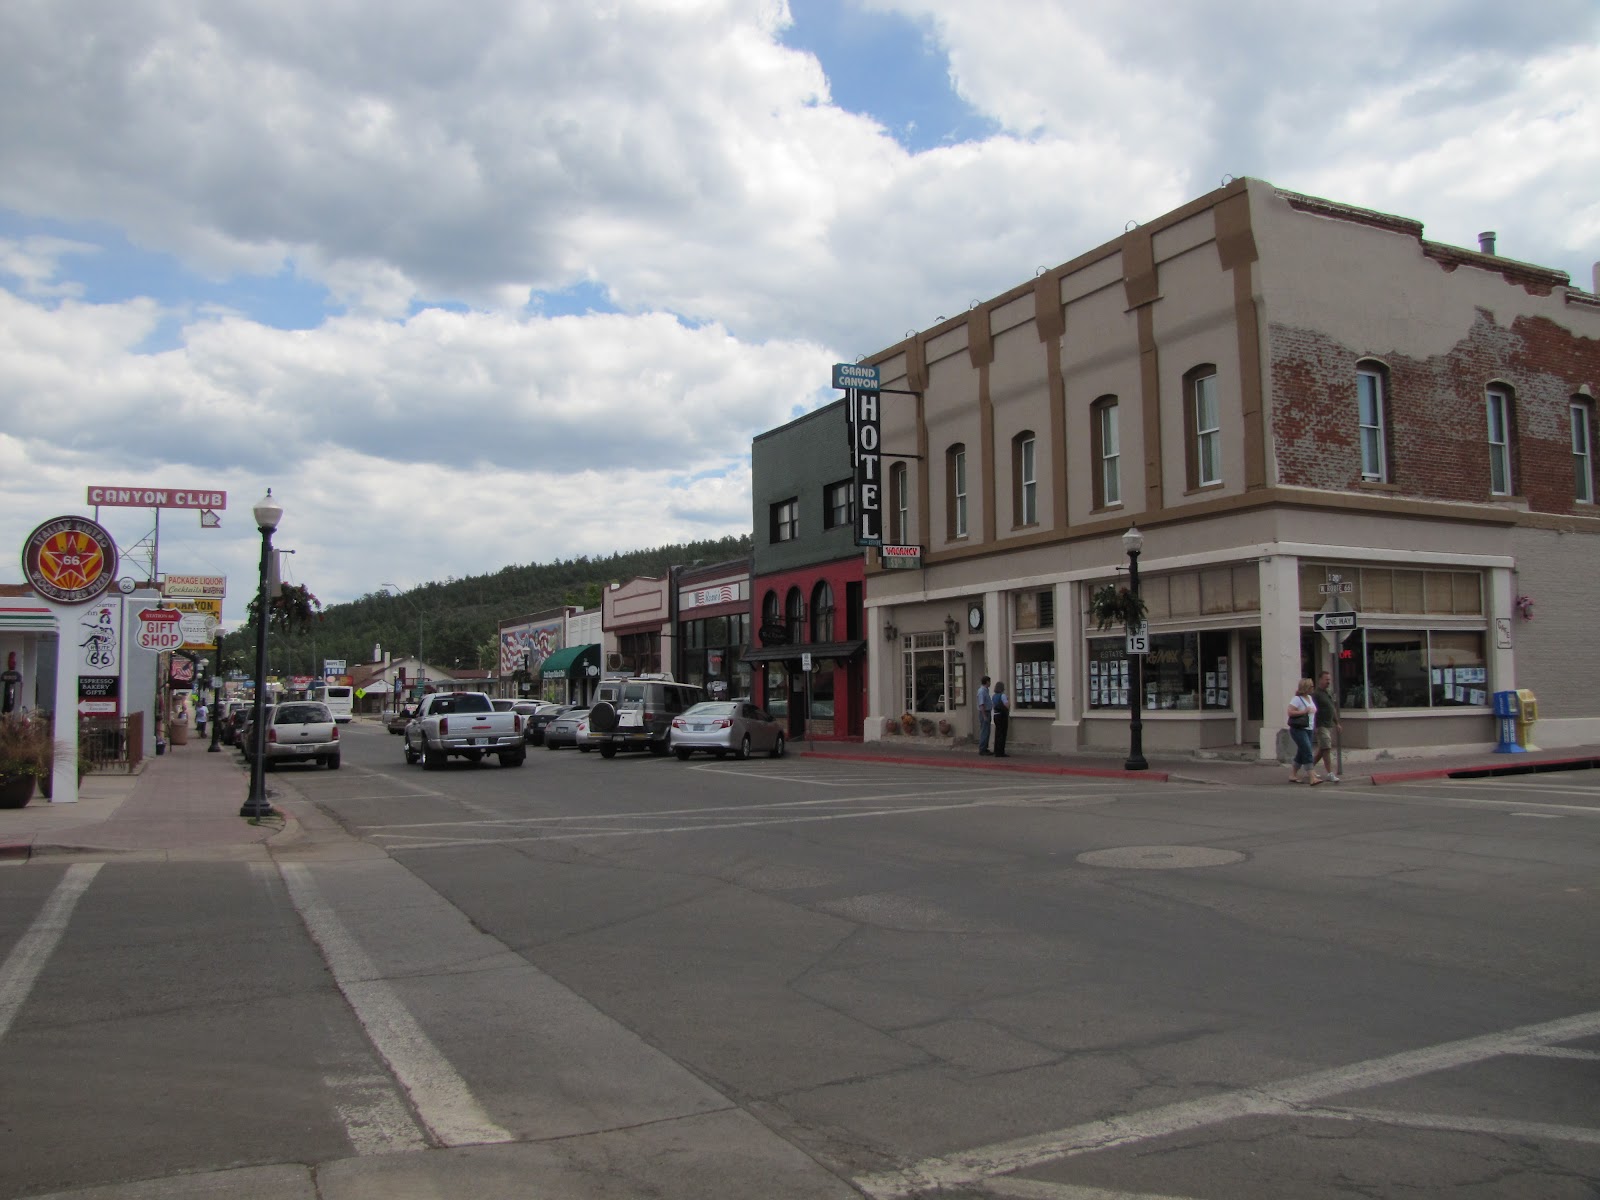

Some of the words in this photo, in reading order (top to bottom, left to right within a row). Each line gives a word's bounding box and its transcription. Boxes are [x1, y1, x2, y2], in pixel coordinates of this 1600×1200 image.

[841, 365, 876, 378] GRAND
[839, 377, 877, 389] CANYON
[860, 395, 879, 539] HOTEL
[92, 489, 167, 504] CANYON
[175, 492, 223, 506] CLUB
[33, 521, 72, 545] ITALIAN
[76, 522, 109, 547] BISTRO
[886, 547, 918, 556] VACANCY
[63, 555, 80, 566] 66
[89, 572, 111, 592] PIZZA
[168, 576, 198, 585] PACKAGE
[200, 577, 224, 586] LIQUOR
[168, 585, 202, 594] Cocktails
[1327, 584, 1342, 592] ROUTE
[1344, 584, 1351, 592] 66
[175, 601, 214, 610] CANYON
[147, 622, 175, 633] GIFT
[1326, 618, 1337, 626] ONE
[1339, 617, 1352, 625] WAY
[142, 634, 179, 647] SHOP
[1130, 638, 1145, 650] 15
[90, 652, 110, 665] 66
[1100, 650, 1124, 659] ESTATE
[1147, 649, 1178, 664] RE/MAX
